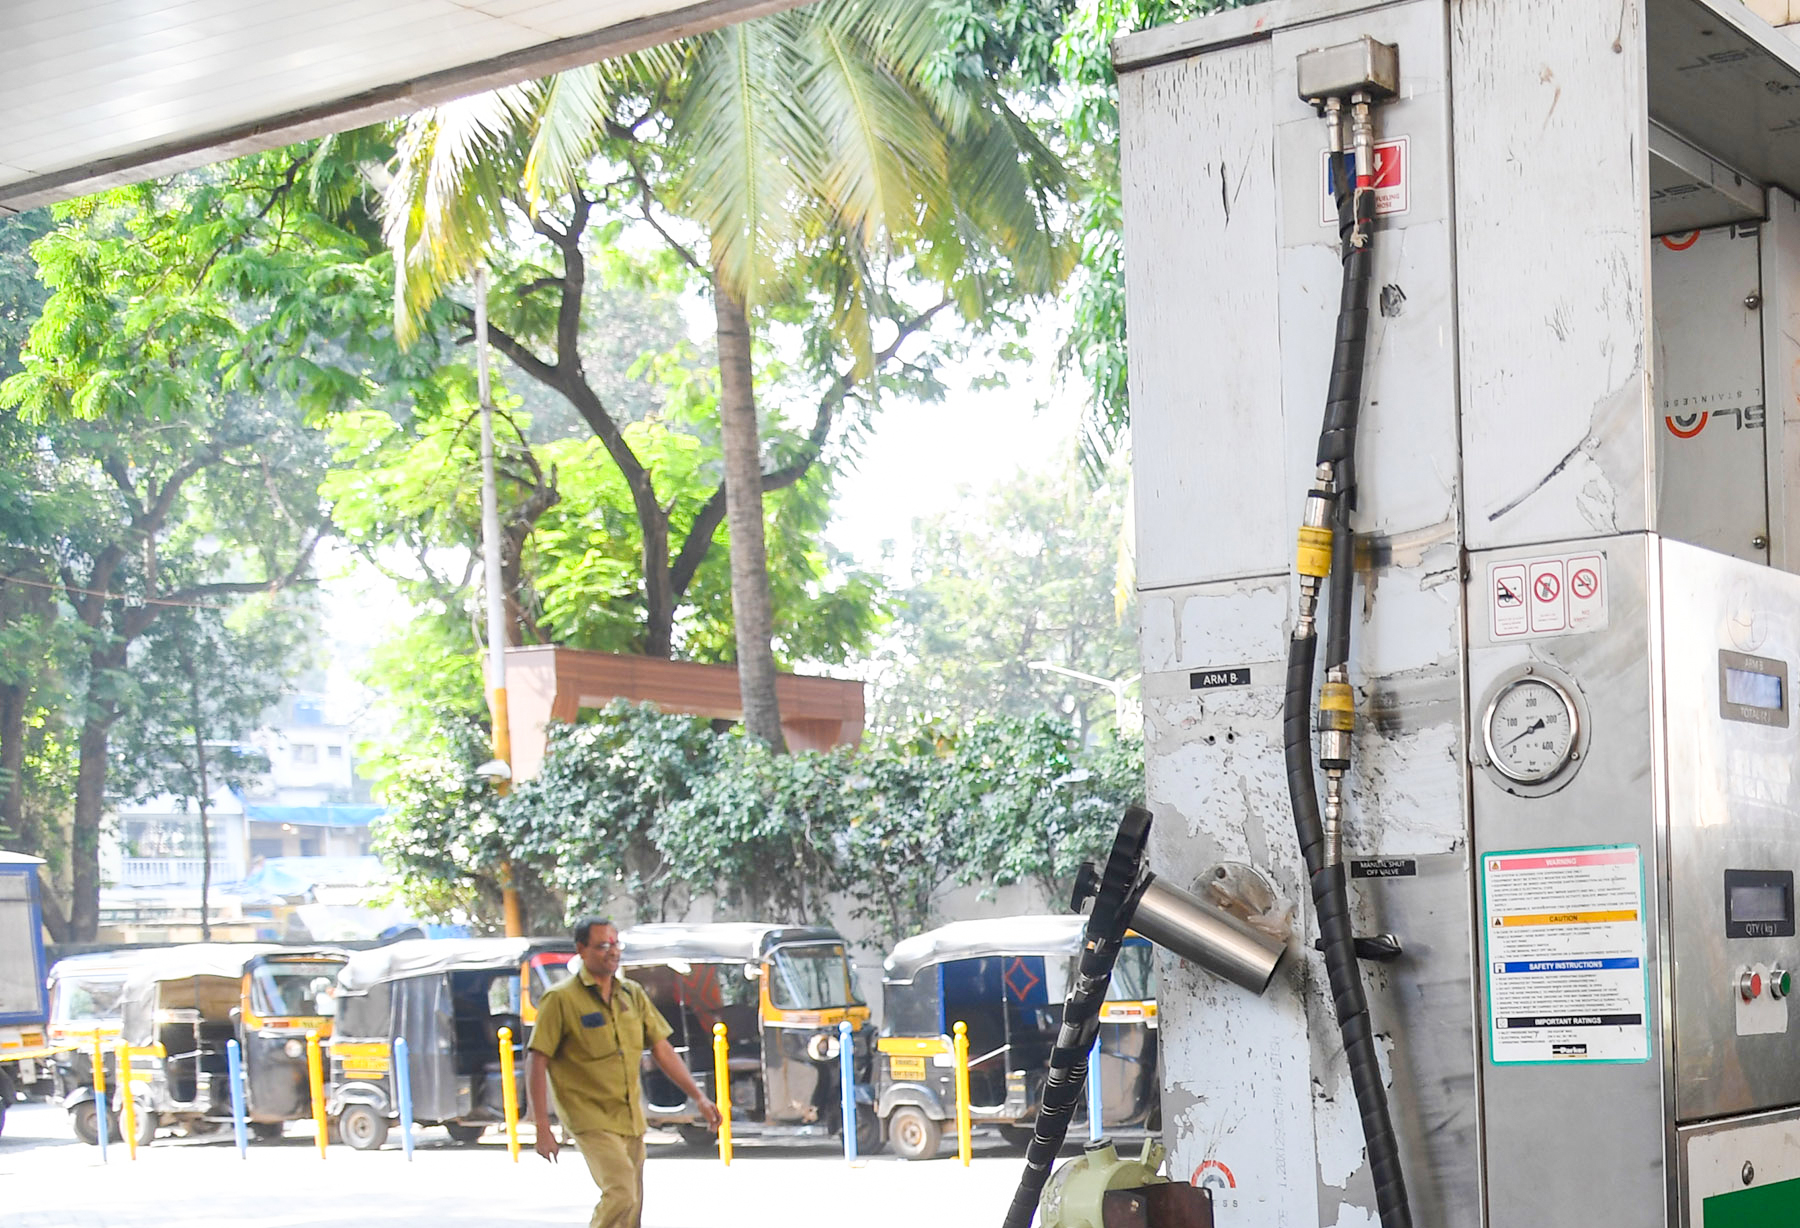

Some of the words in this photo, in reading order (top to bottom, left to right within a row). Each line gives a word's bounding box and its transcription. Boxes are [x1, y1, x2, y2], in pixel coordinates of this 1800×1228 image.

[1711, 404, 1765, 431] SL
[1203, 674, 1228, 686] ARM
[1230, 672, 1238, 684] B
[1526, 698, 1537, 708] 200
[1507, 718, 1518, 727] 100
[1546, 715, 1557, 724] 300
[1513, 745, 1517, 754] 0
[1542, 741, 1553, 750] 400
[1389, 860, 1405, 868] SHUT
[1546, 858, 1577, 867] WARNING
[1380, 868, 1399, 876] VALVE
[1549, 914, 1578, 923] CAUTION
[1529, 962, 1554, 971] SAFETY
[1555, 960, 1603, 970] INSTRUCTIONS
[1535, 1017, 1572, 1026] IMPORTANT
[1573, 1016, 1602, 1025] RATINGS
[1560, 1046, 1586, 1054] Parker
